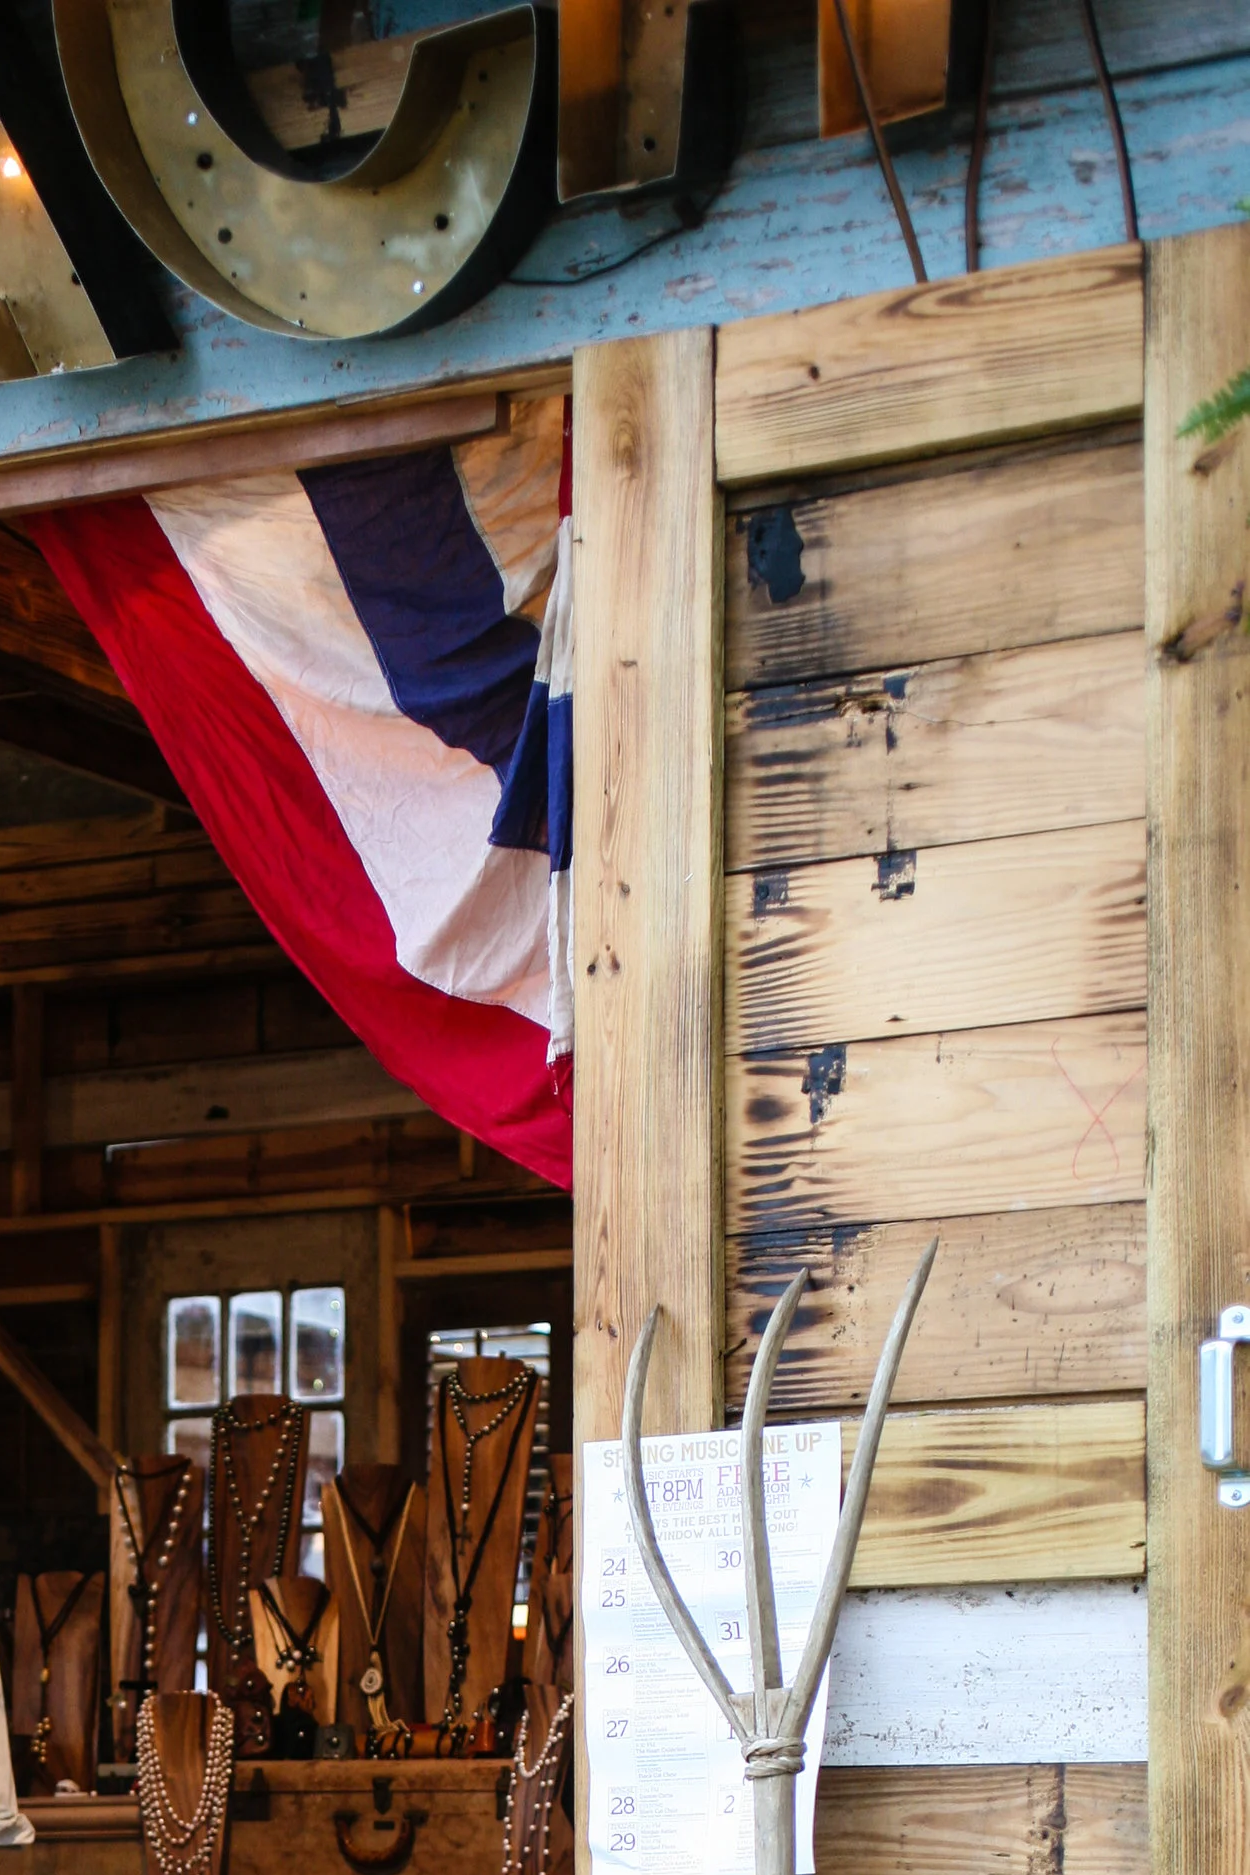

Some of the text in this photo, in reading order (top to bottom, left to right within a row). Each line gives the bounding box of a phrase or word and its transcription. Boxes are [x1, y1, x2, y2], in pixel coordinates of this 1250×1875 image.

[603, 1444, 674, 1468] SPING
[681, 1438, 739, 1462] MUSIC
[795, 1431, 822, 1453] UP
[666, 1467, 703, 1480] STARTS
[662, 1478, 703, 1502] 8PM
[717, 1483, 790, 1497] ADMION
[662, 1501, 703, 1512] EVENINGS
[716, 1493, 791, 1508] EVER GHT!
[625, 1518, 669, 1531] AYS
[673, 1517, 695, 1527] THE
[698, 1513, 728, 1525] BEST
[773, 1509, 799, 1521] OUT
[708, 1526, 730, 1537] ALL
[768, 1522, 798, 1533] ONG!
[603, 1557, 628, 1577] 24
[717, 1551, 742, 1569] 30
[602, 1589, 626, 1608] 25
[721, 1621, 742, 1641] 31
[606, 1655, 630, 1674] 26
[607, 1719, 629, 1738] 27
[611, 1796, 635, 1815] 28
[723, 1794, 734, 1814] 2
[610, 1832, 636, 1852] 29
